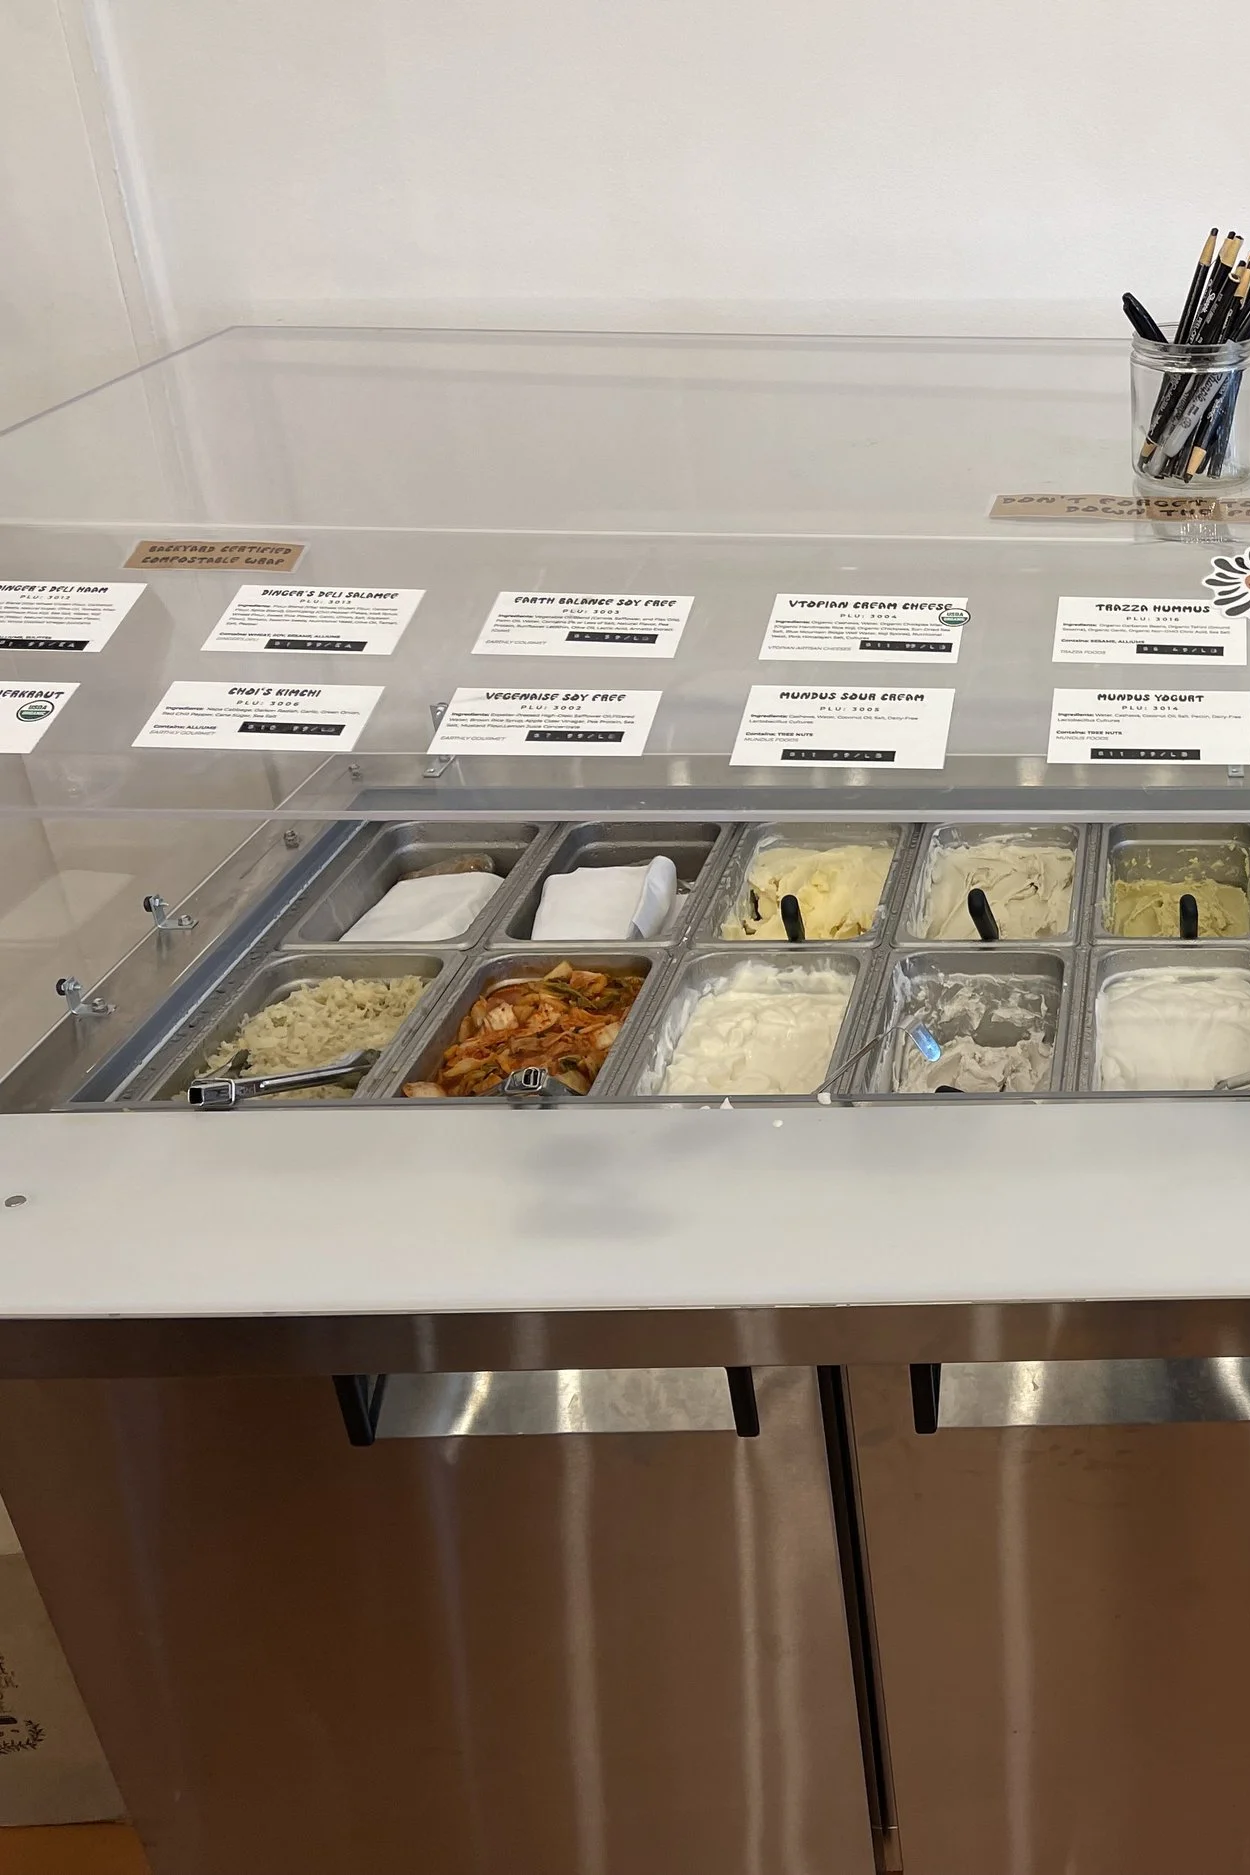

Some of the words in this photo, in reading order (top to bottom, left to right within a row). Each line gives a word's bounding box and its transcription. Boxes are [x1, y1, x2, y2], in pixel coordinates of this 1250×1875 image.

[1065, 506, 1145, 515] DOWN
[149, 545, 215, 553] BACKYARD
[220, 545, 292, 554] CERTIFIED
[142, 556, 240, 564] COMPOSTABLE
[262, 589, 315, 597] DINGER'S
[514, 596, 555, 605] EARTH
[558, 598, 613, 606] BALANCE
[617, 599, 641, 607] SOY
[644, 599, 677, 607] FREE
[789, 600, 849, 608] VTOPIAN
[853, 601, 897, 610] CREAM
[902, 602, 953, 611] CHEESE
[1096, 604, 1148, 612] TRAZZA
[1153, 605, 1210, 613] HUMMUS
[228, 687, 272, 696] CHOI'S
[276, 688, 322, 698] KIMCHI
[486, 692, 559, 701] VEGENAISE
[562, 693, 589, 701] SOY
[592, 694, 627, 702] FREE
[780, 691, 836, 700] MUNDUS
[840, 692, 876, 701] SOUR
[881, 693, 924, 701] CREAM
[1097, 693, 1150, 701] MUNDUS
[1154, 694, 1204, 702] YOGURT
